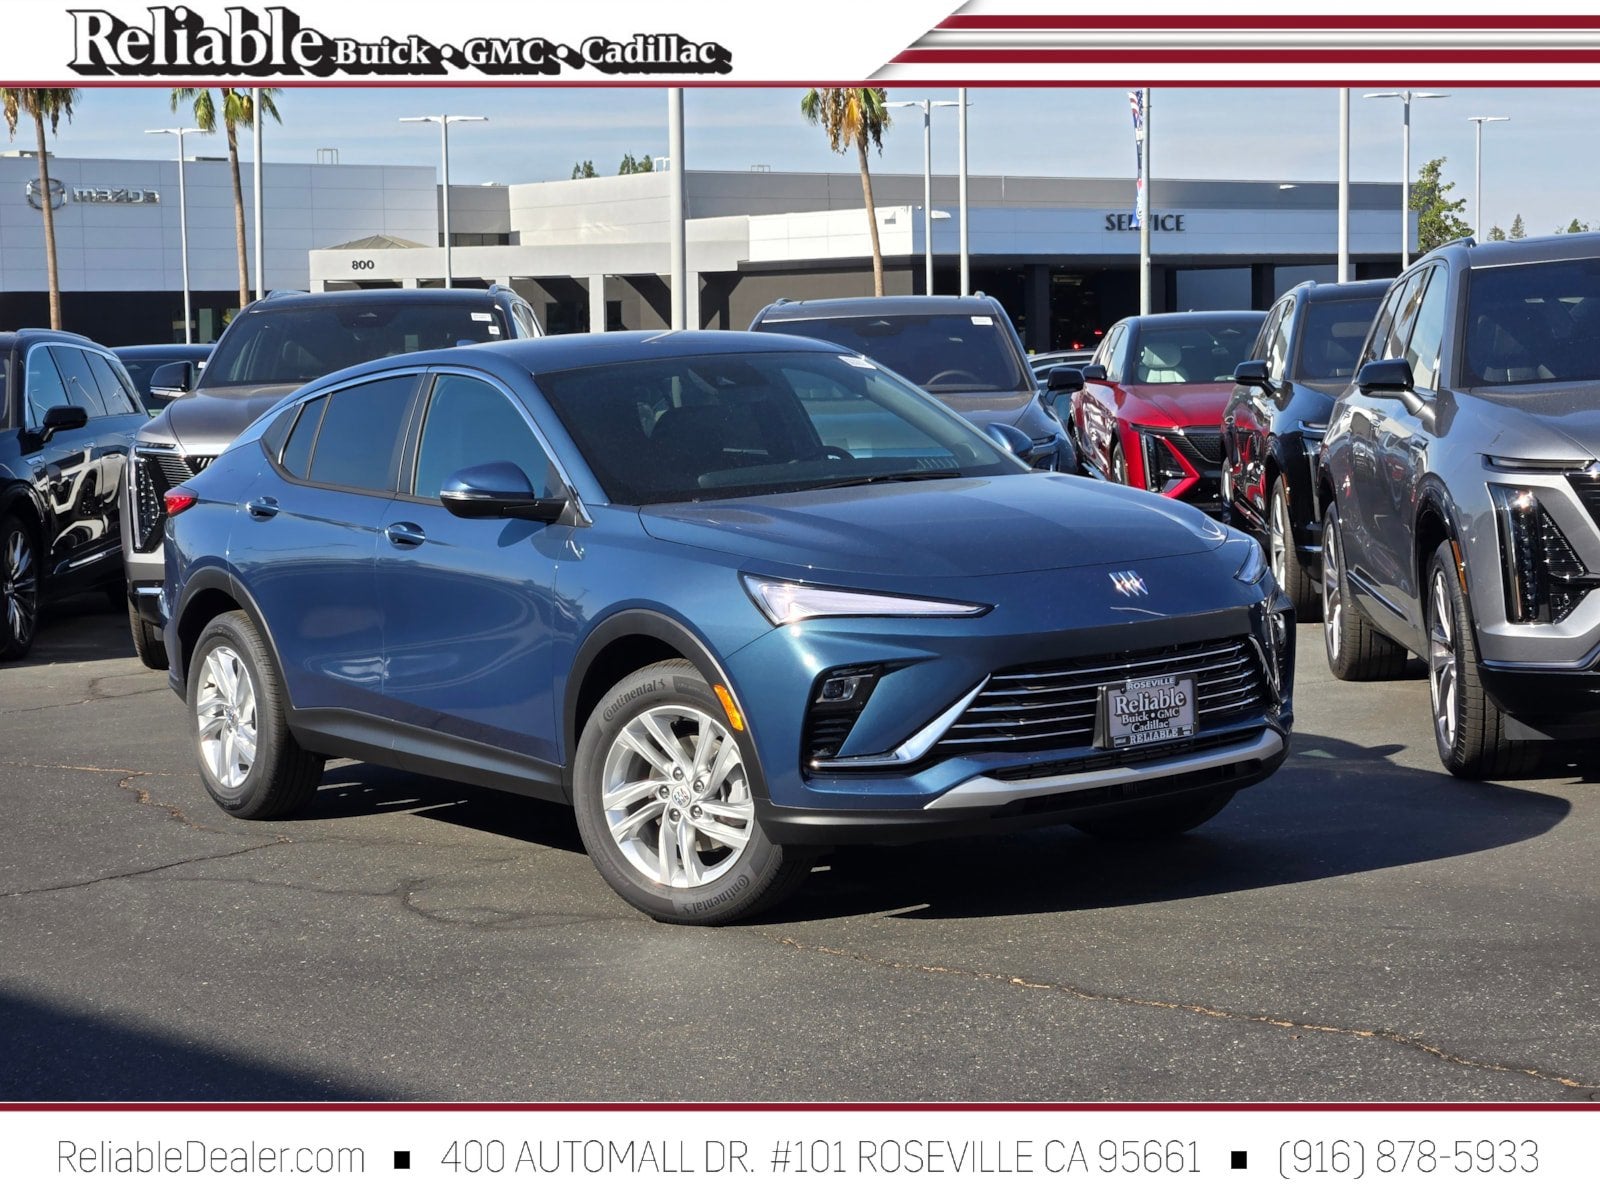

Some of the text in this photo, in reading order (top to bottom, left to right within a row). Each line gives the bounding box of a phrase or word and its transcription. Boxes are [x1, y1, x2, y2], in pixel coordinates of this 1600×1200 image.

[1105, 213, 1186, 231] SEICE
[352, 260, 375, 270] 800
[1127, 677, 1175, 690] ROSEVILLE
[603, 679, 658, 722] Continental
[1116, 688, 1185, 715] Reliable
[1121, 706, 1180, 724] Buick GMC
[1131, 720, 1170, 733] Cadillac
[1129, 728, 1179, 745] RELIABLE
